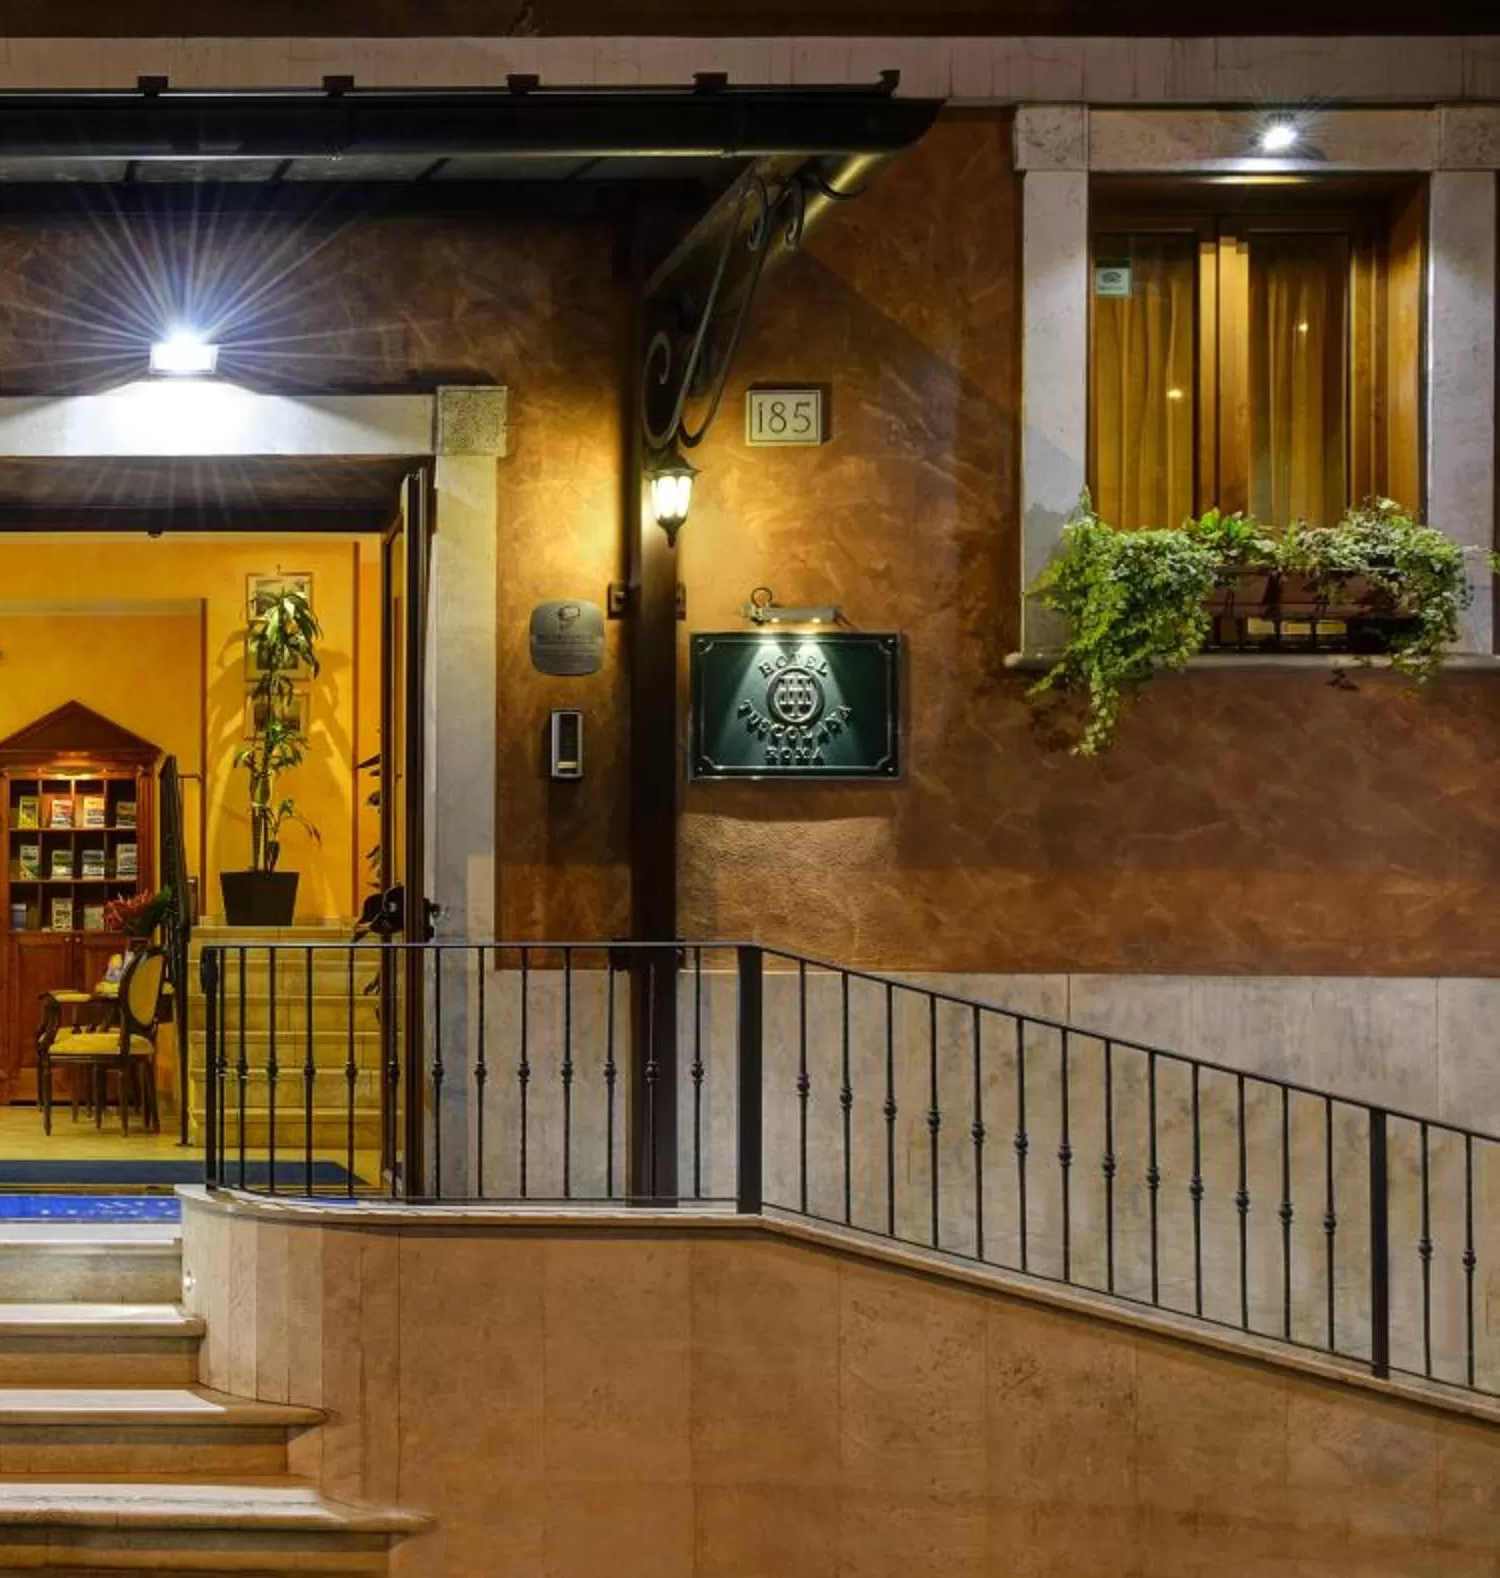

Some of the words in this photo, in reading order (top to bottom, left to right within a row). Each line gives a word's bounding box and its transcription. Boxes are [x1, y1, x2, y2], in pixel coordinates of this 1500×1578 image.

[758, 401, 811, 434] 185
[758, 653, 829, 678] HOTEL
[764, 746, 825, 759] ROMA
